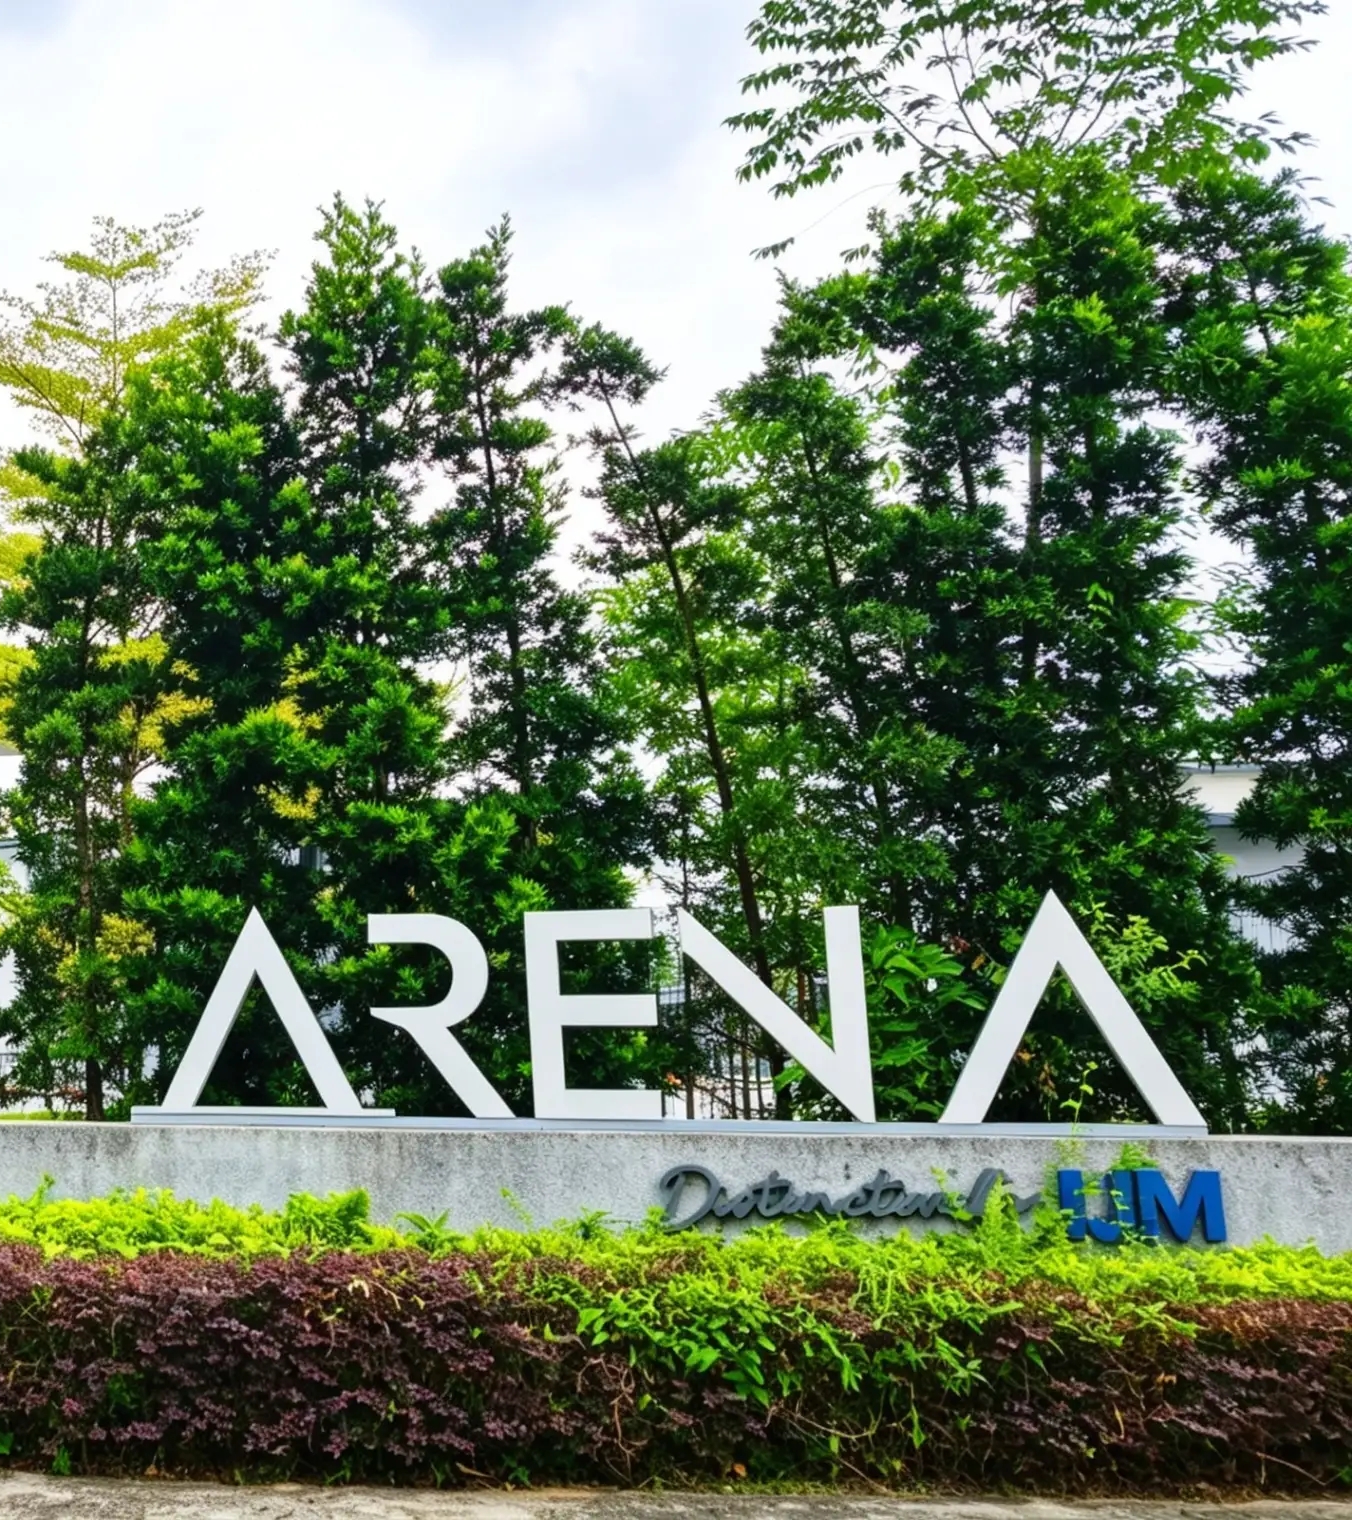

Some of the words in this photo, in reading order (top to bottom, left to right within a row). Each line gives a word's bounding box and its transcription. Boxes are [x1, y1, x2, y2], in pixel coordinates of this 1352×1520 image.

[162, 889, 1206, 1126] ARENA
[659, 1164, 1042, 1233] Distinctivl
[1057, 1168, 1227, 1242] IJM
